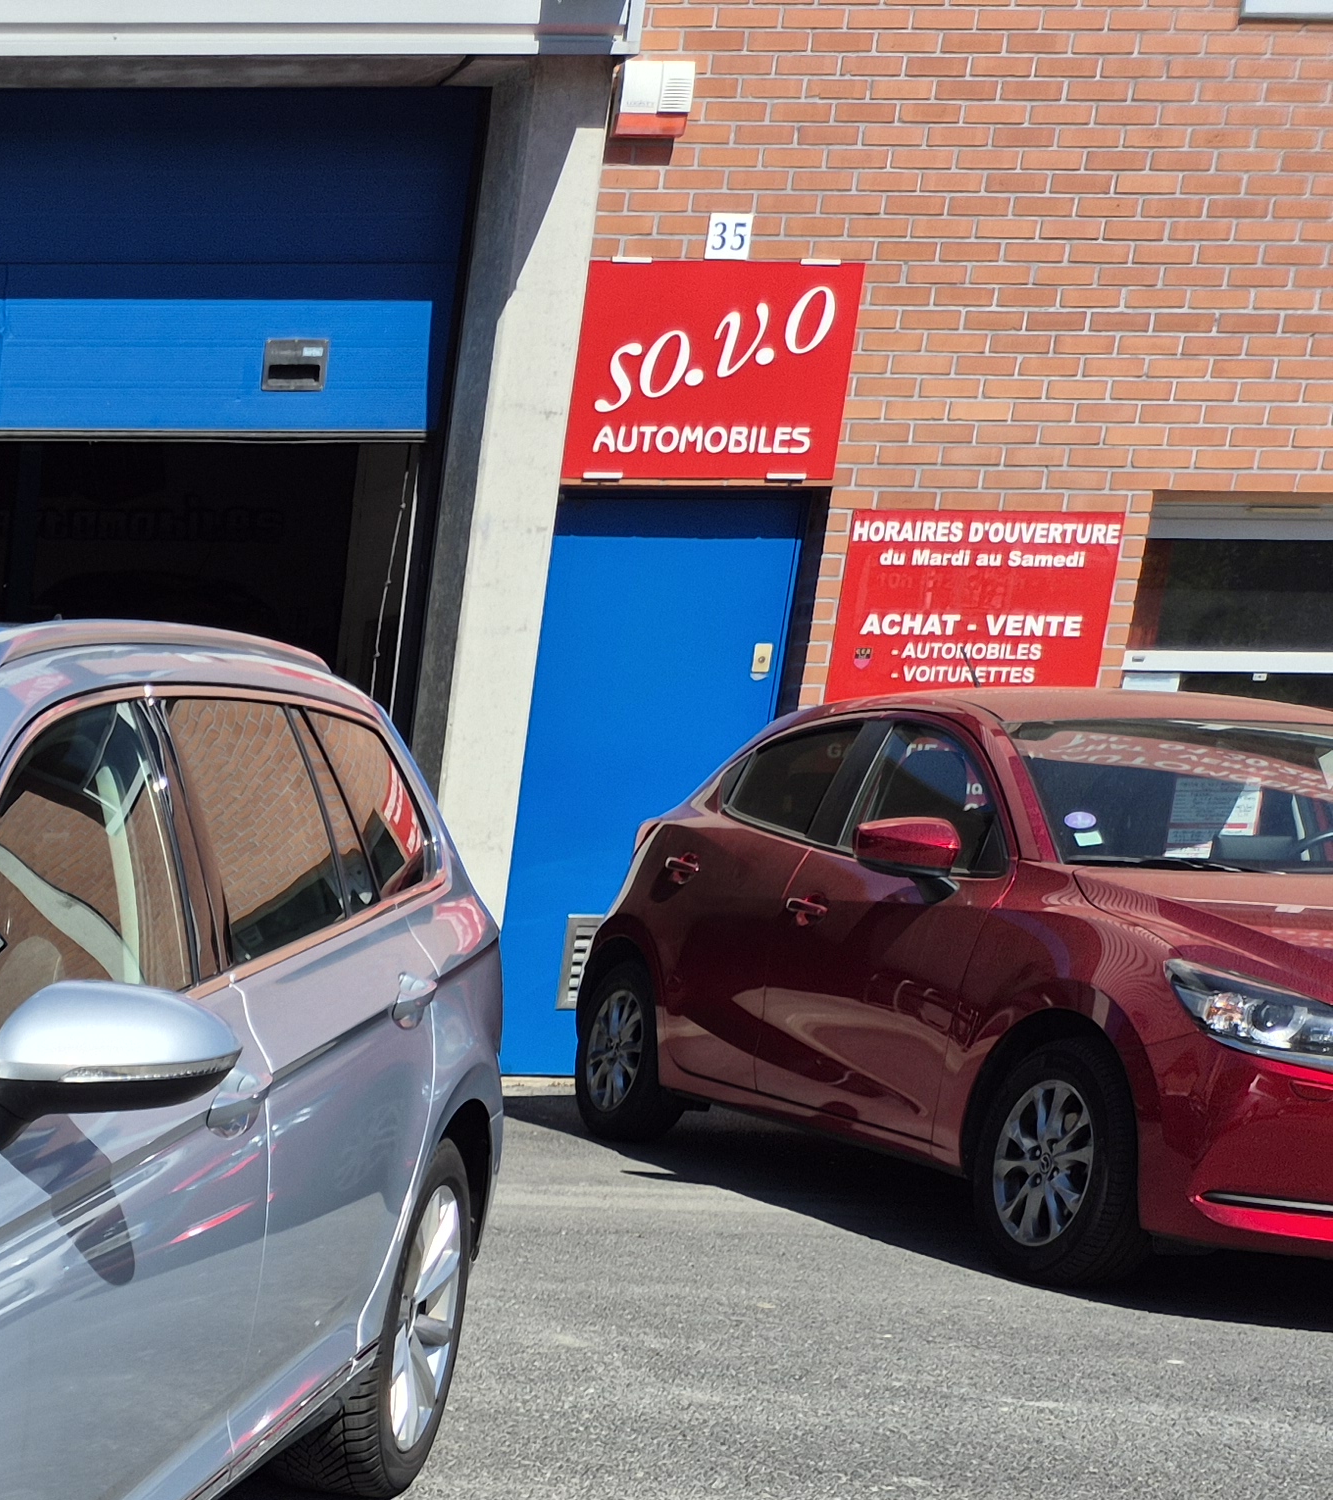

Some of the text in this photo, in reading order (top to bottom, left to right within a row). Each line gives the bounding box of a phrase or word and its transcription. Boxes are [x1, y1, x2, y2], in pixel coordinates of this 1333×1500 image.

[711, 222, 748, 251] 35
[592, 425, 811, 454] AUTOMOBILES
[852, 520, 1121, 545] HORAIRES D'OUVERTURE
[879, 549, 1086, 568] du Mardi au Samedi
[860, 613, 962, 636] ACHAT
[986, 614, 1083, 637] VENTE
[901, 642, 1043, 661] AUTOMOBILES
[903, 665, 1036, 683] VOITURETTES
